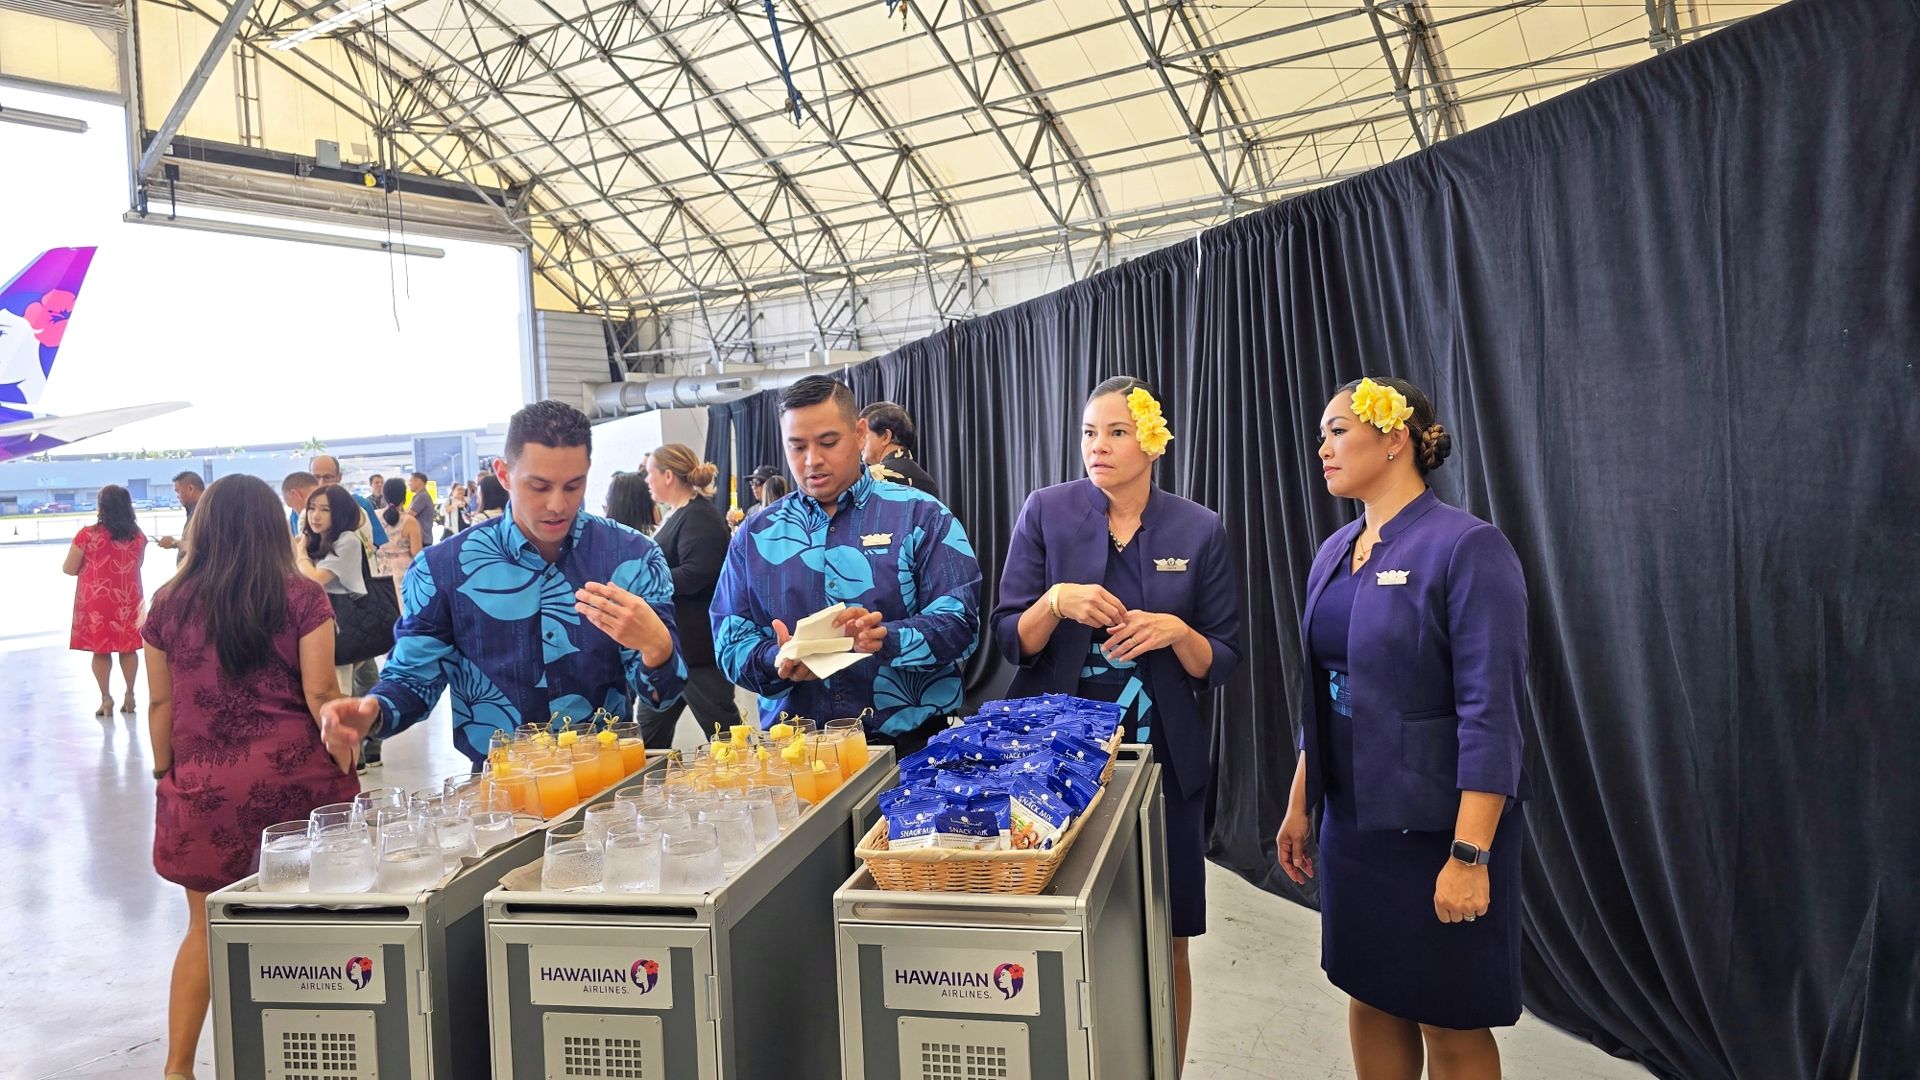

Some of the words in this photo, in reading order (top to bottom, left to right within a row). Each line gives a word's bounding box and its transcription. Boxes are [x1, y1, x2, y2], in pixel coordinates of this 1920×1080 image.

[1018, 795, 1040, 813] SNACK
[1038, 809, 1053, 822] MIX
[900, 827, 922, 838] SNACK
[948, 826, 973, 835] SNACK
[974, 828, 989, 836] MIX
[260, 965, 342, 980] HAWAIIAN
[540, 967, 627, 983] HAWAIIAN
[895, 969, 989, 988] HAWAIIAN
